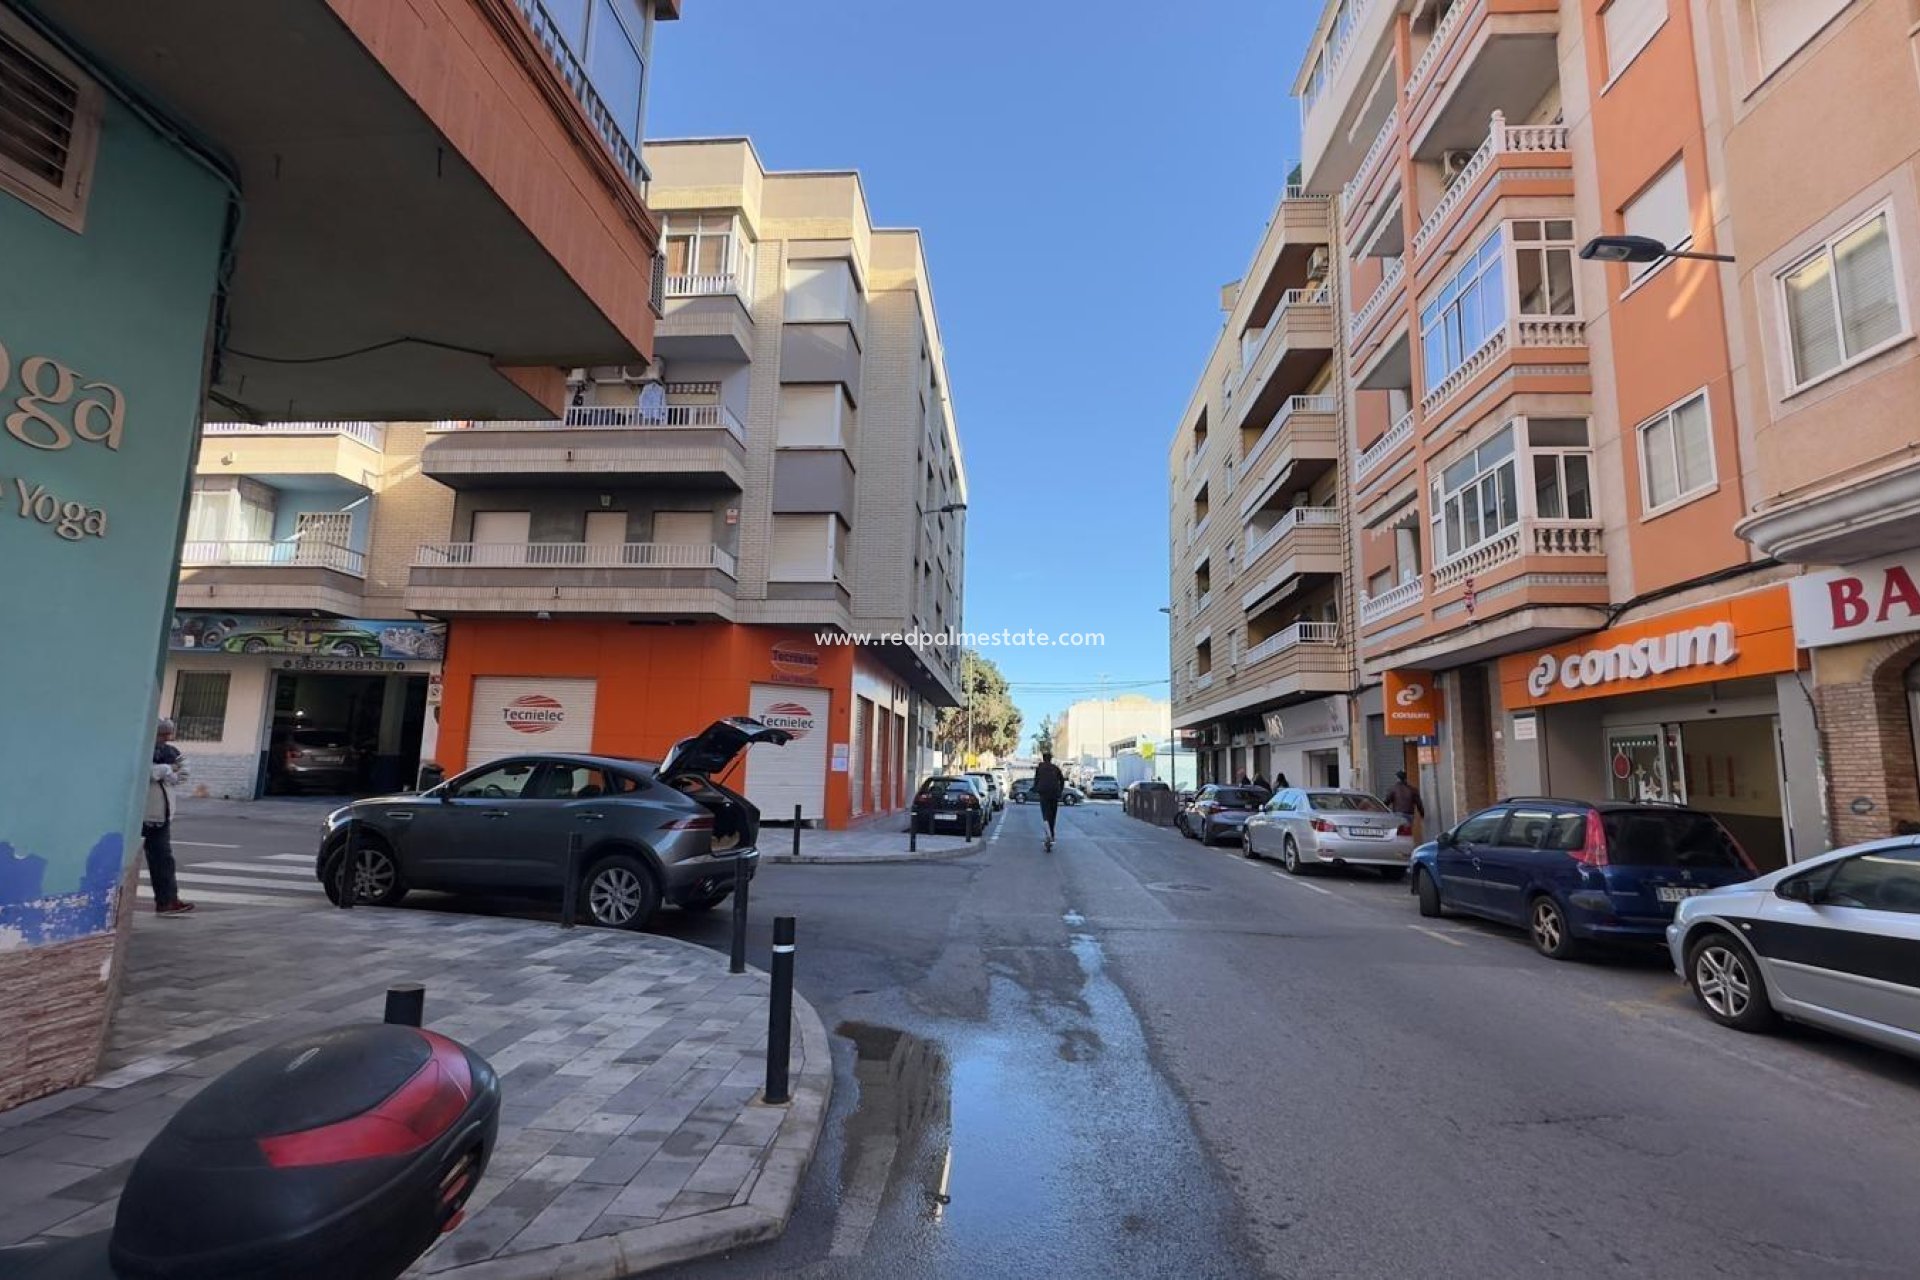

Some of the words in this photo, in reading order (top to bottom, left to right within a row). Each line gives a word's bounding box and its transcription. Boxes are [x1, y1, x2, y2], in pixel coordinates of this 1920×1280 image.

[15, 477, 107, 540] Yoga
[1561, 621, 1740, 688] consum
[503, 708, 564, 721] Tecnielec
[759, 714, 814, 729] Tecnielec
[1392, 711, 1431, 719] consum
